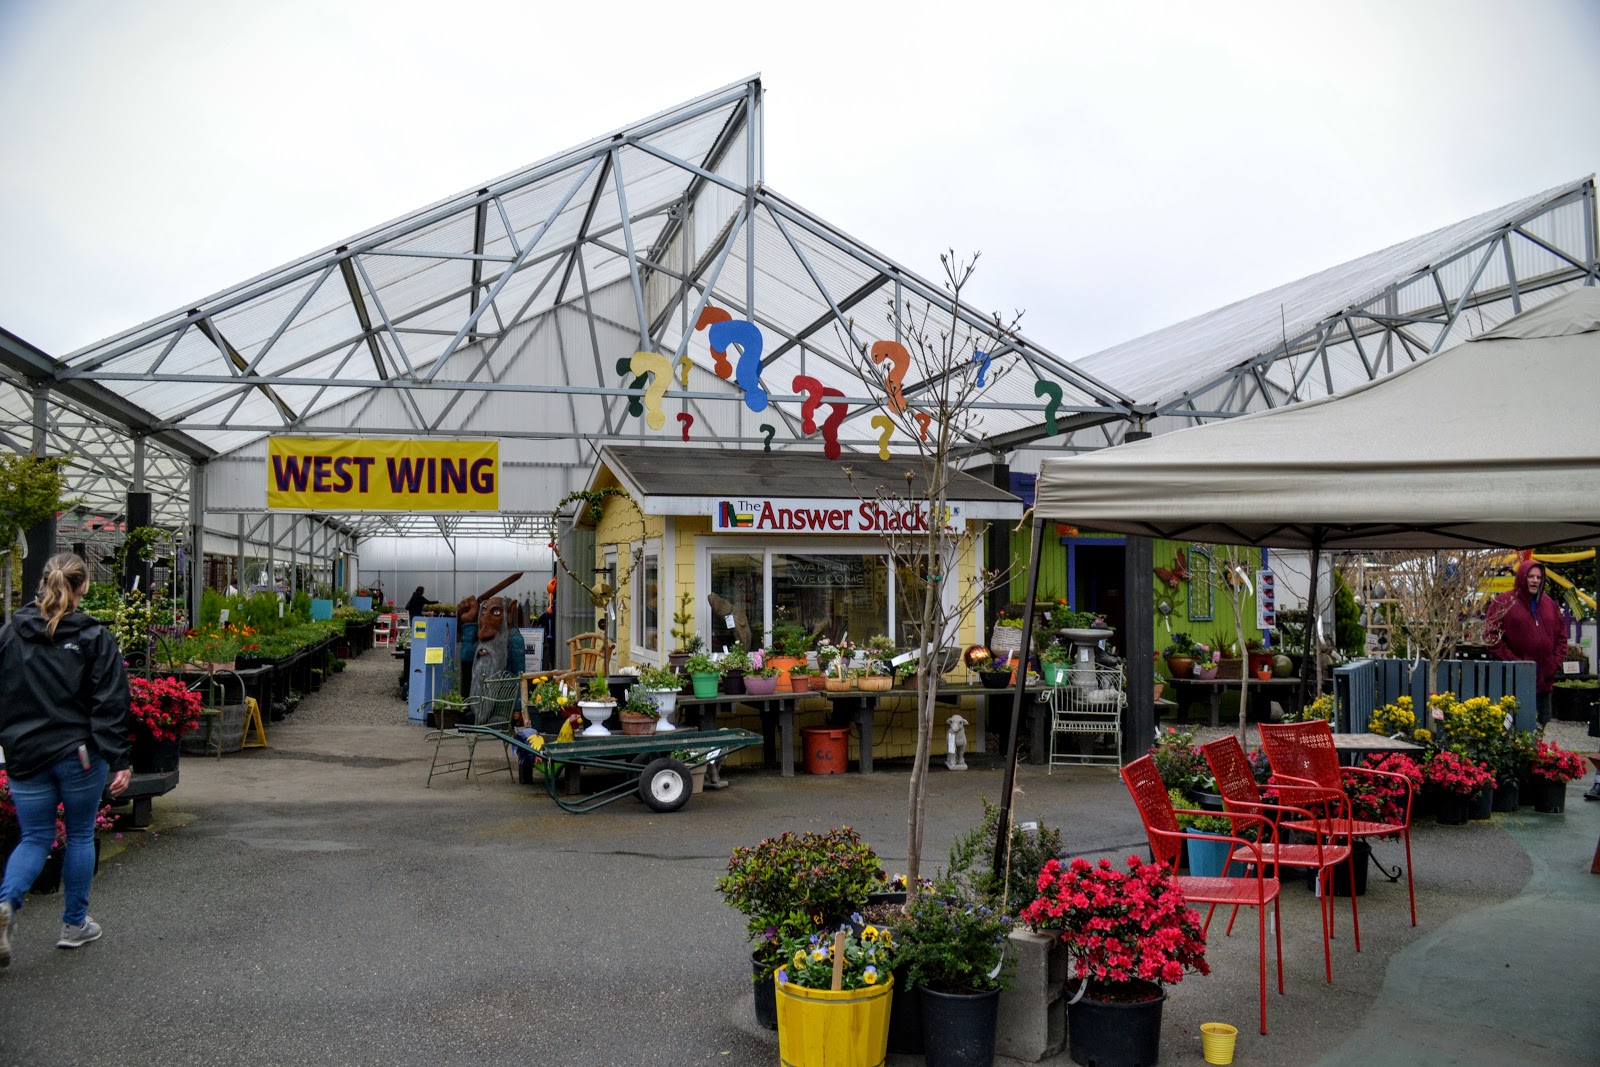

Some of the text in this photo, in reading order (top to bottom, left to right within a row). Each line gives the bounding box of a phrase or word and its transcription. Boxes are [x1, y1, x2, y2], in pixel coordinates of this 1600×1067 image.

[272, 455, 494, 494] WEST WING
[738, 500, 930, 531] The Answer Shack
[791, 574, 864, 584] WELCOME
